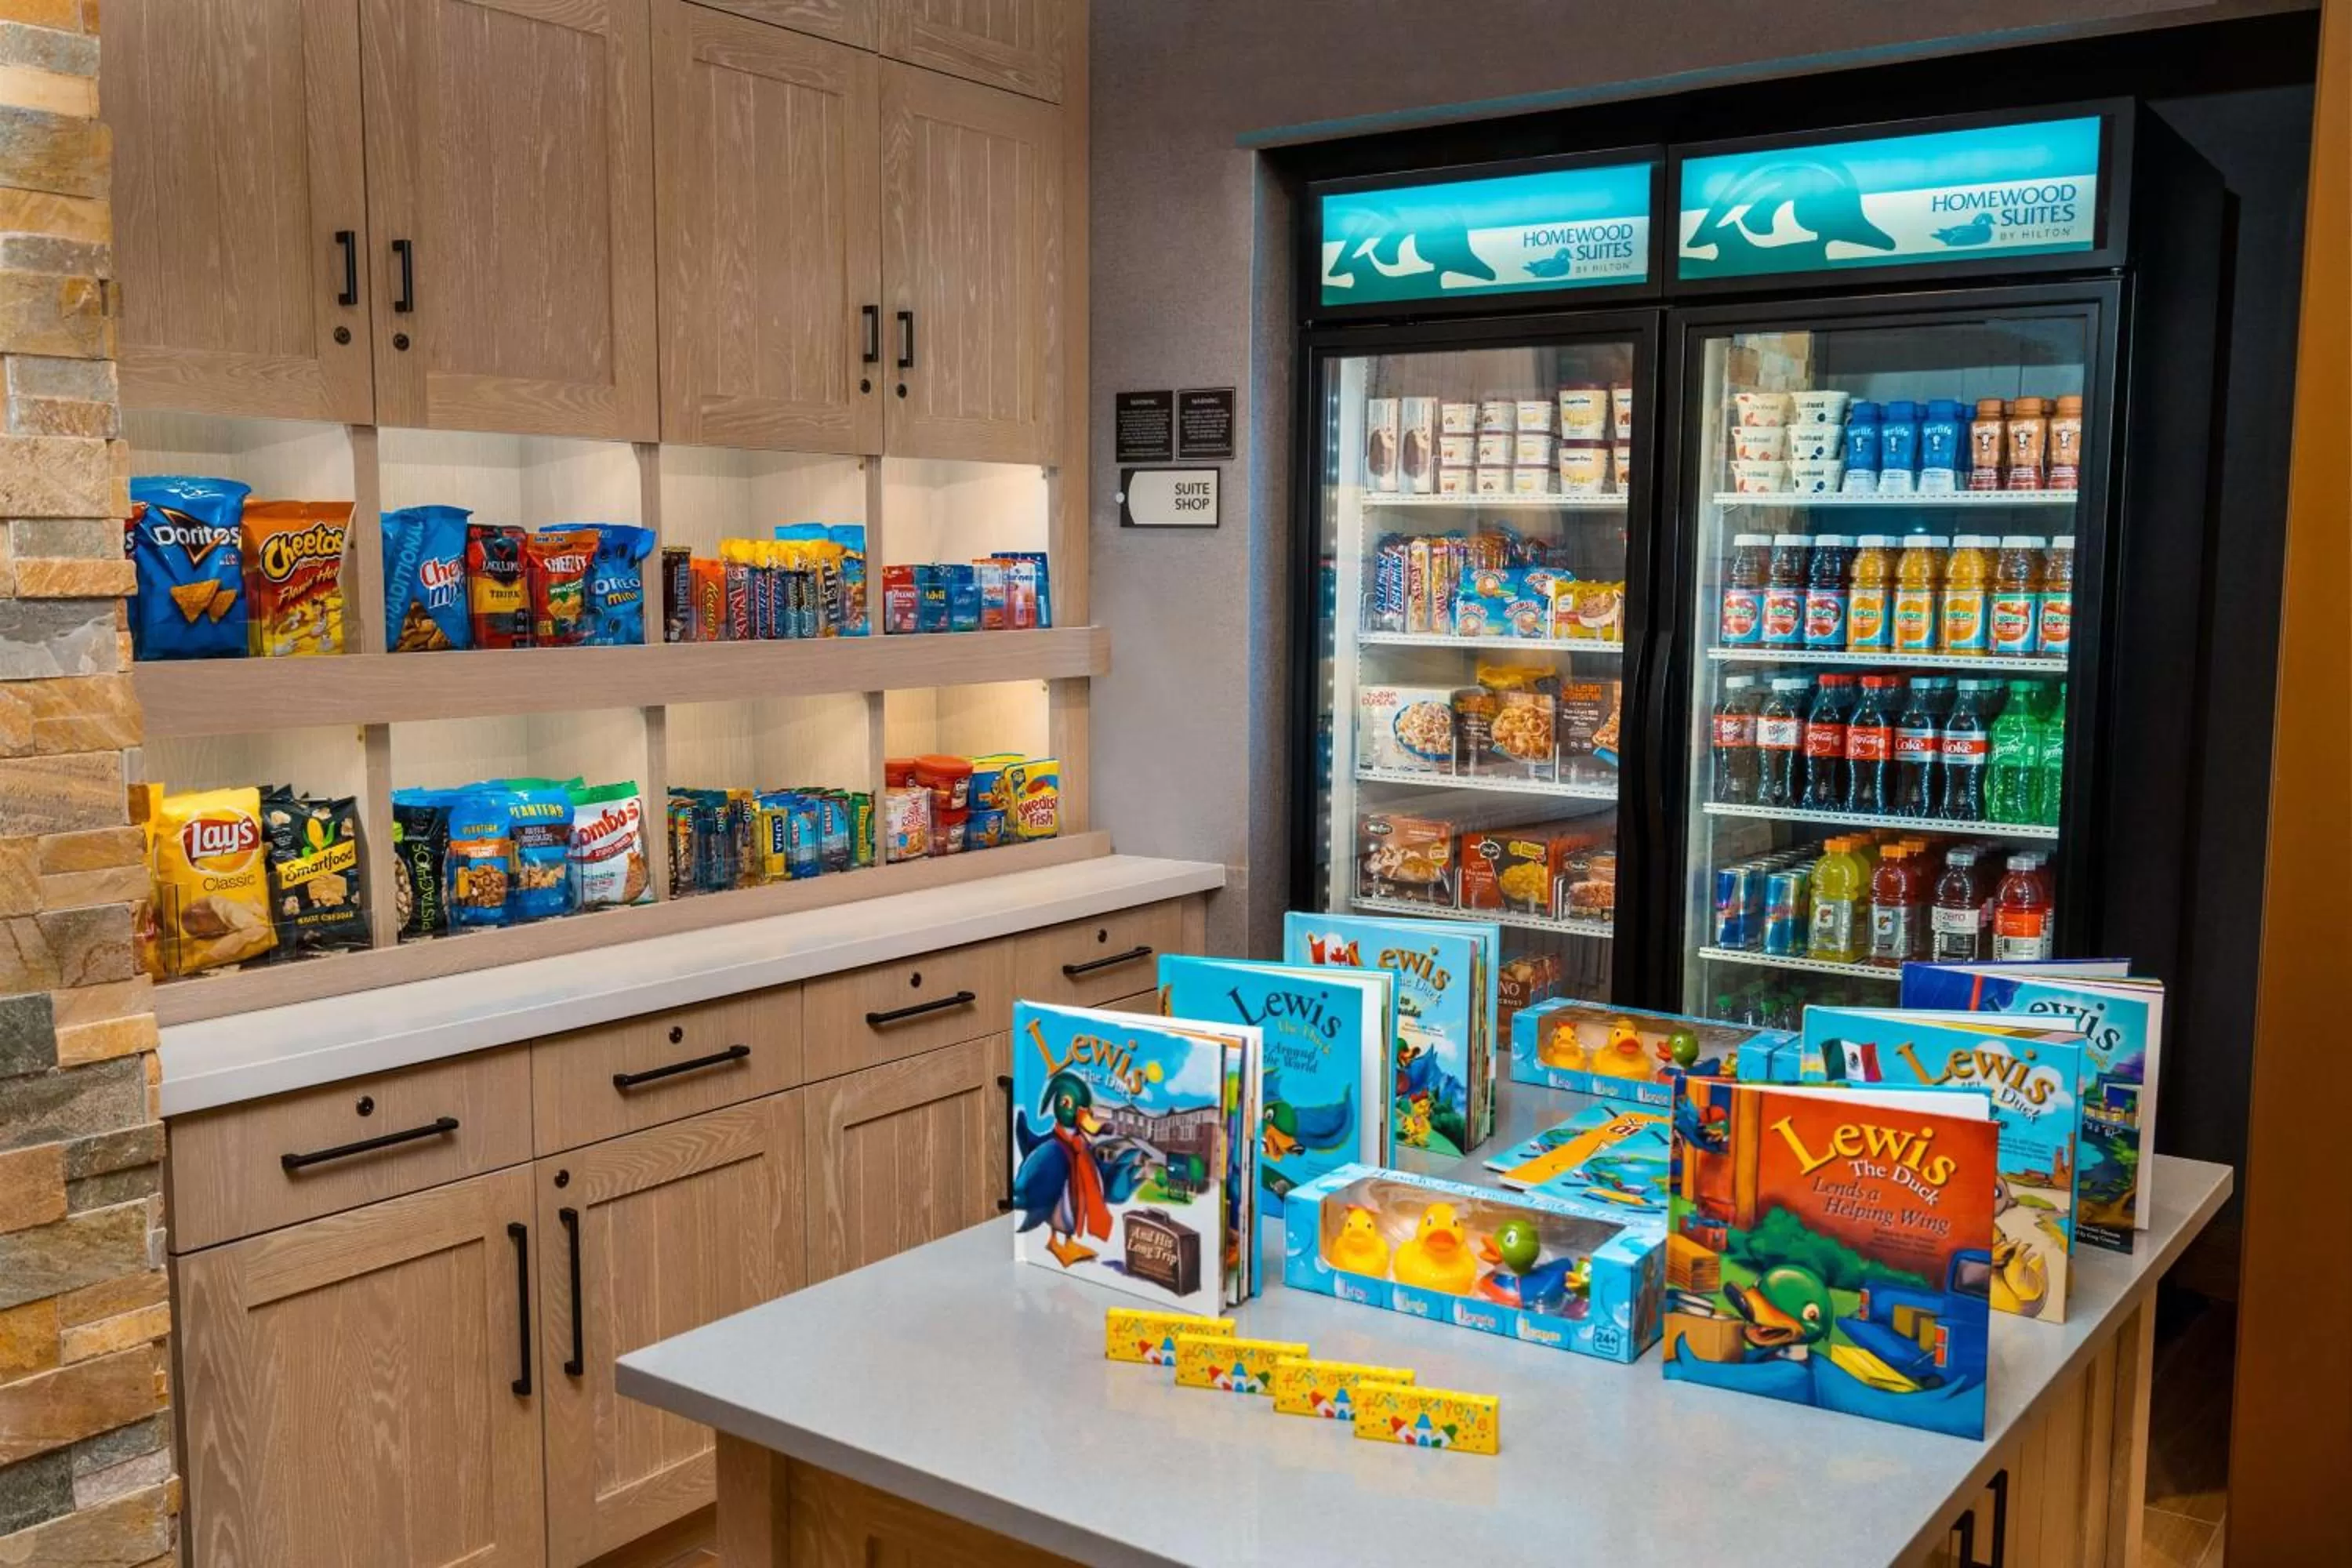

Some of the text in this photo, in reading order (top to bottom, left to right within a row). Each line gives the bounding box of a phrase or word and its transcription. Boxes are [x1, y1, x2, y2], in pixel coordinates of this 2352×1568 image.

[1932, 183, 2078, 212] HOMEWOOD
[2000, 204, 2076, 227] SUITES
[1523, 223, 1634, 248] HOMEWOOD
[2021, 228, 2071, 239] HILTON
[1576, 241, 1633, 261] SUITES
[1174, 482, 1210, 495] SUITE
[1174, 498, 1210, 510] SHOP
[153, 525, 241, 546] Doritos
[263, 526, 343, 579] Cheetos
[593, 577, 641, 594] OREO
[1895, 739, 1926, 750] Coke
[1942, 740, 1973, 753] Coke
[1018, 795, 1058, 821] Swedis
[1029, 811, 1053, 829] Fish
[192, 818, 255, 859] Lay's
[285, 848, 354, 883] Smartfood
[202, 873, 258, 892] Classic
[1225, 985, 1342, 1039] Lewis
[1024, 1018, 1150, 1095] Lewis
[1272, 1040, 1318, 1059] Around
[1283, 1055, 1319, 1074] World
[1896, 1040, 2056, 1105] Lewis
[1998, 1087, 2042, 1124] Duck
[1770, 1116, 1957, 1187] Lewis
[1813, 1176, 1880, 1202] Lends a
[1849, 1160, 1939, 1207] The Duck
[1824, 1198, 1951, 1236] Helping Wing
[1131, 1226, 1174, 1250] And His
[1127, 1237, 1178, 1267] Long Trip
